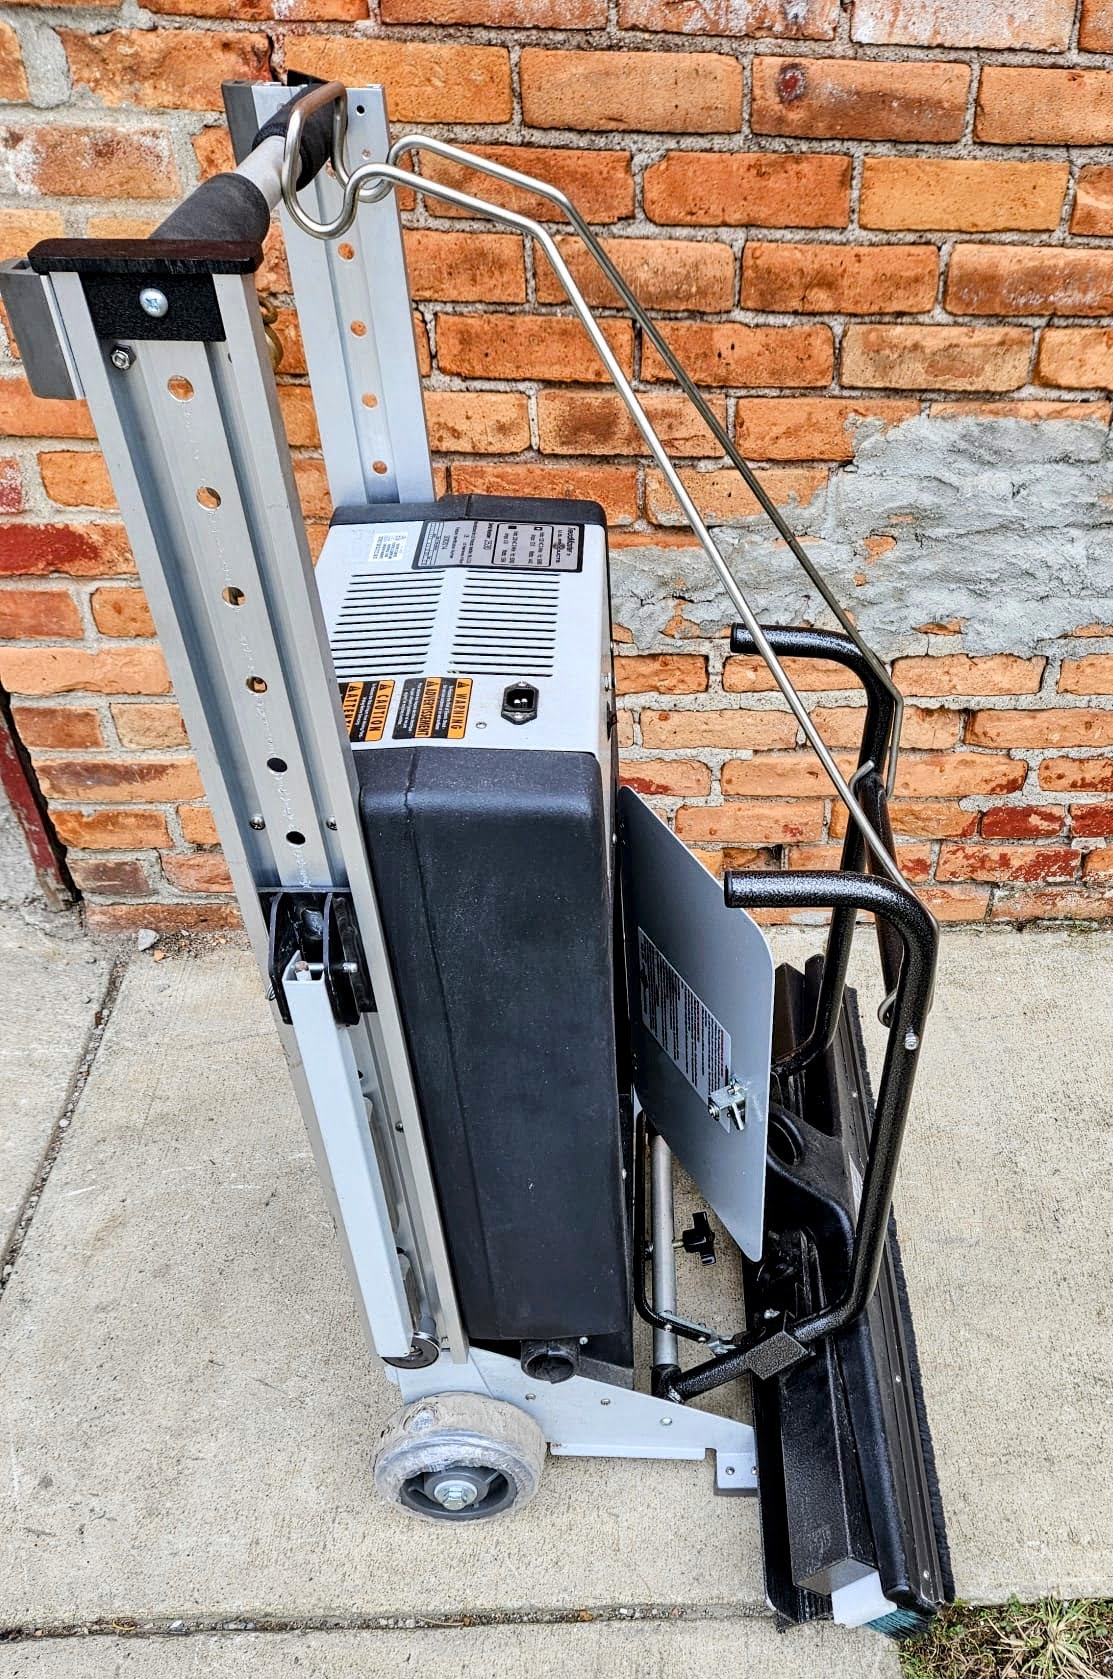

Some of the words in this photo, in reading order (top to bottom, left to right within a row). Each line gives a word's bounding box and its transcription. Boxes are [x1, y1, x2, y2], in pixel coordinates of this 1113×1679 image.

[369, 694, 388, 732] CAUTION
[418, 688, 437, 736] ADVERTISSEMENT
[450, 693, 468, 730] WARNING
